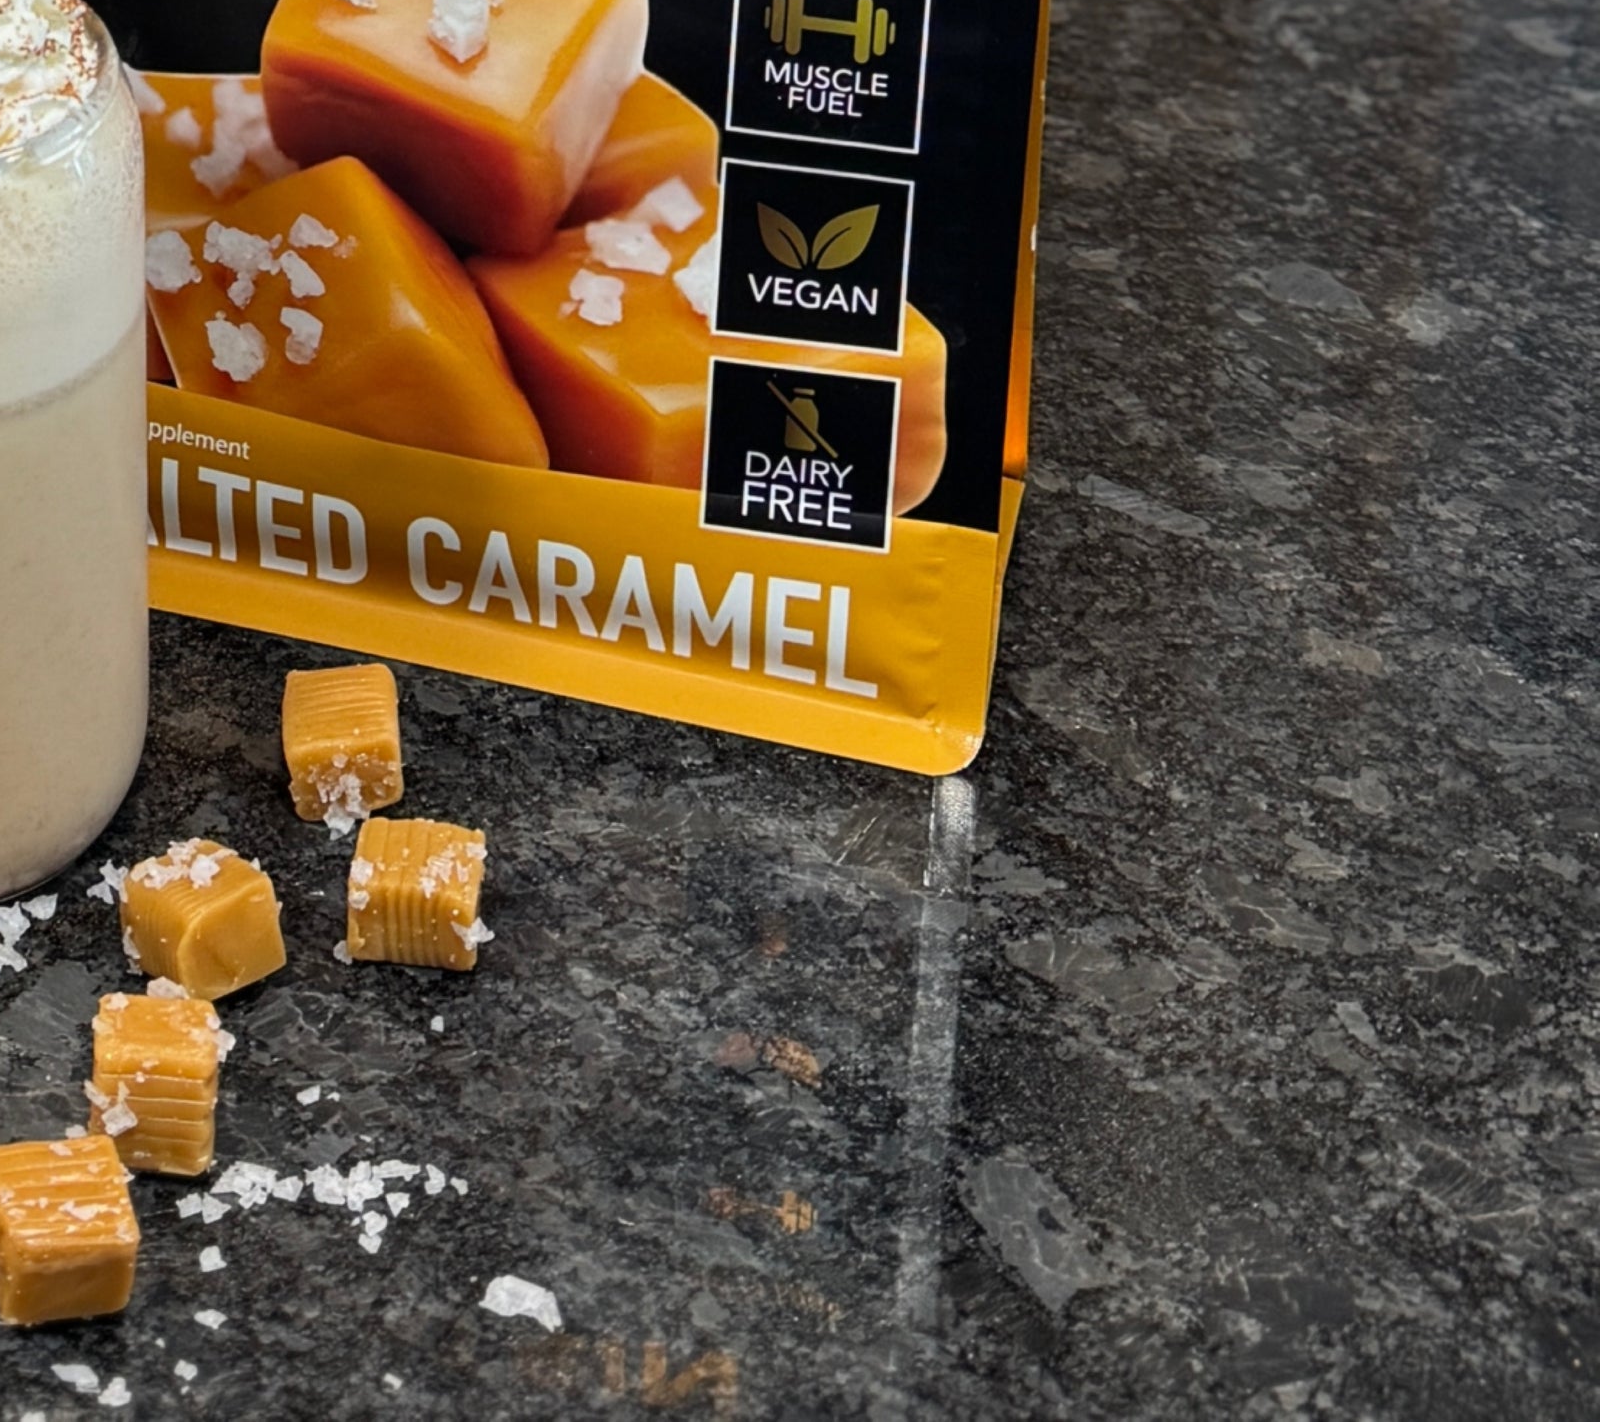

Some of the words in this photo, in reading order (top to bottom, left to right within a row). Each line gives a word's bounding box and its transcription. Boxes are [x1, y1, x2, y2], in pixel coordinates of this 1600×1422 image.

[764, 59, 889, 97] MUSCLE
[787, 88, 863, 118] FUEL
[747, 272, 879, 316] VEGAN
[147, 421, 251, 461] pplement
[744, 451, 854, 489] DAIRY
[740, 481, 854, 532] FREE
[147, 457, 369, 586] LTED
[406, 516, 879, 700] CARAMEL
